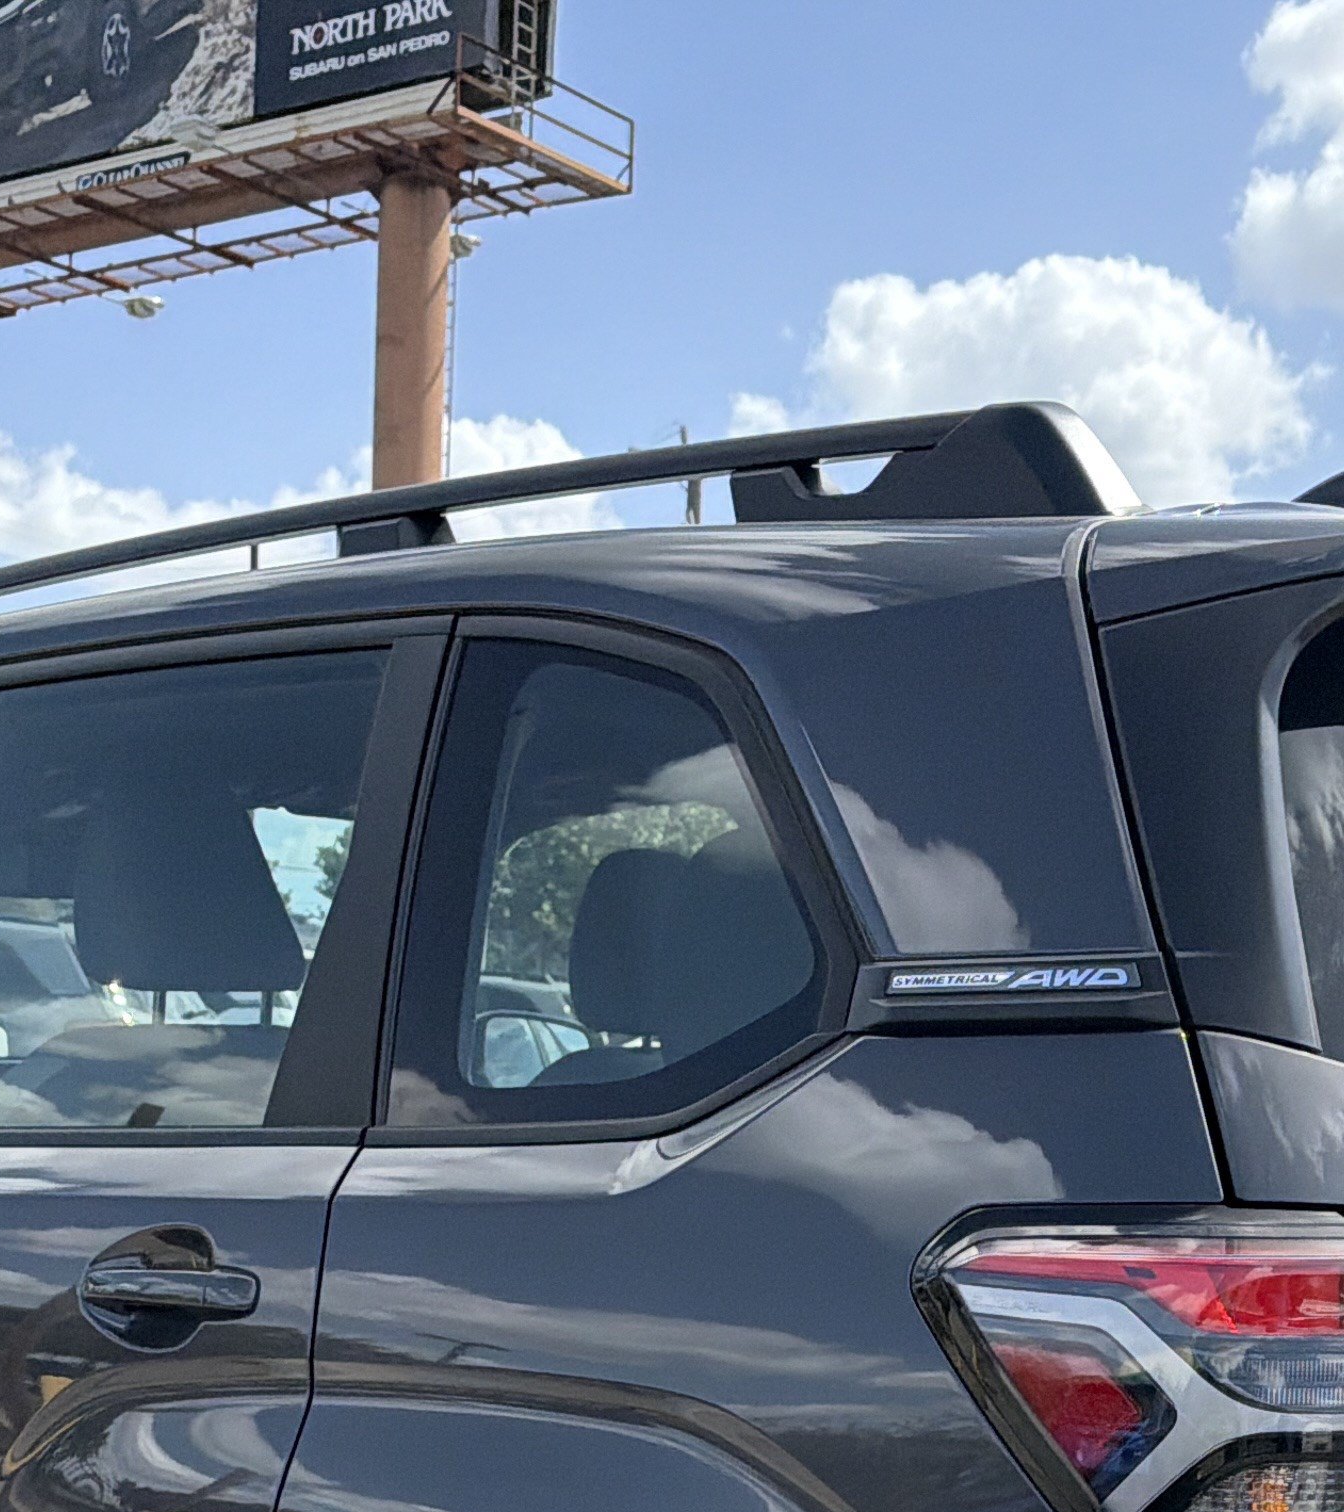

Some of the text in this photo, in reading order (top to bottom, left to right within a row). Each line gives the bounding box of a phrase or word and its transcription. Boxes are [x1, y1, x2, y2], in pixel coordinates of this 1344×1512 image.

[289, 0, 453, 55] NORTH PARK
[289, 30, 450, 82] SUBARU on SAN PEDRO
[894, 967, 1128, 989] SYMMETRICAL AWD
